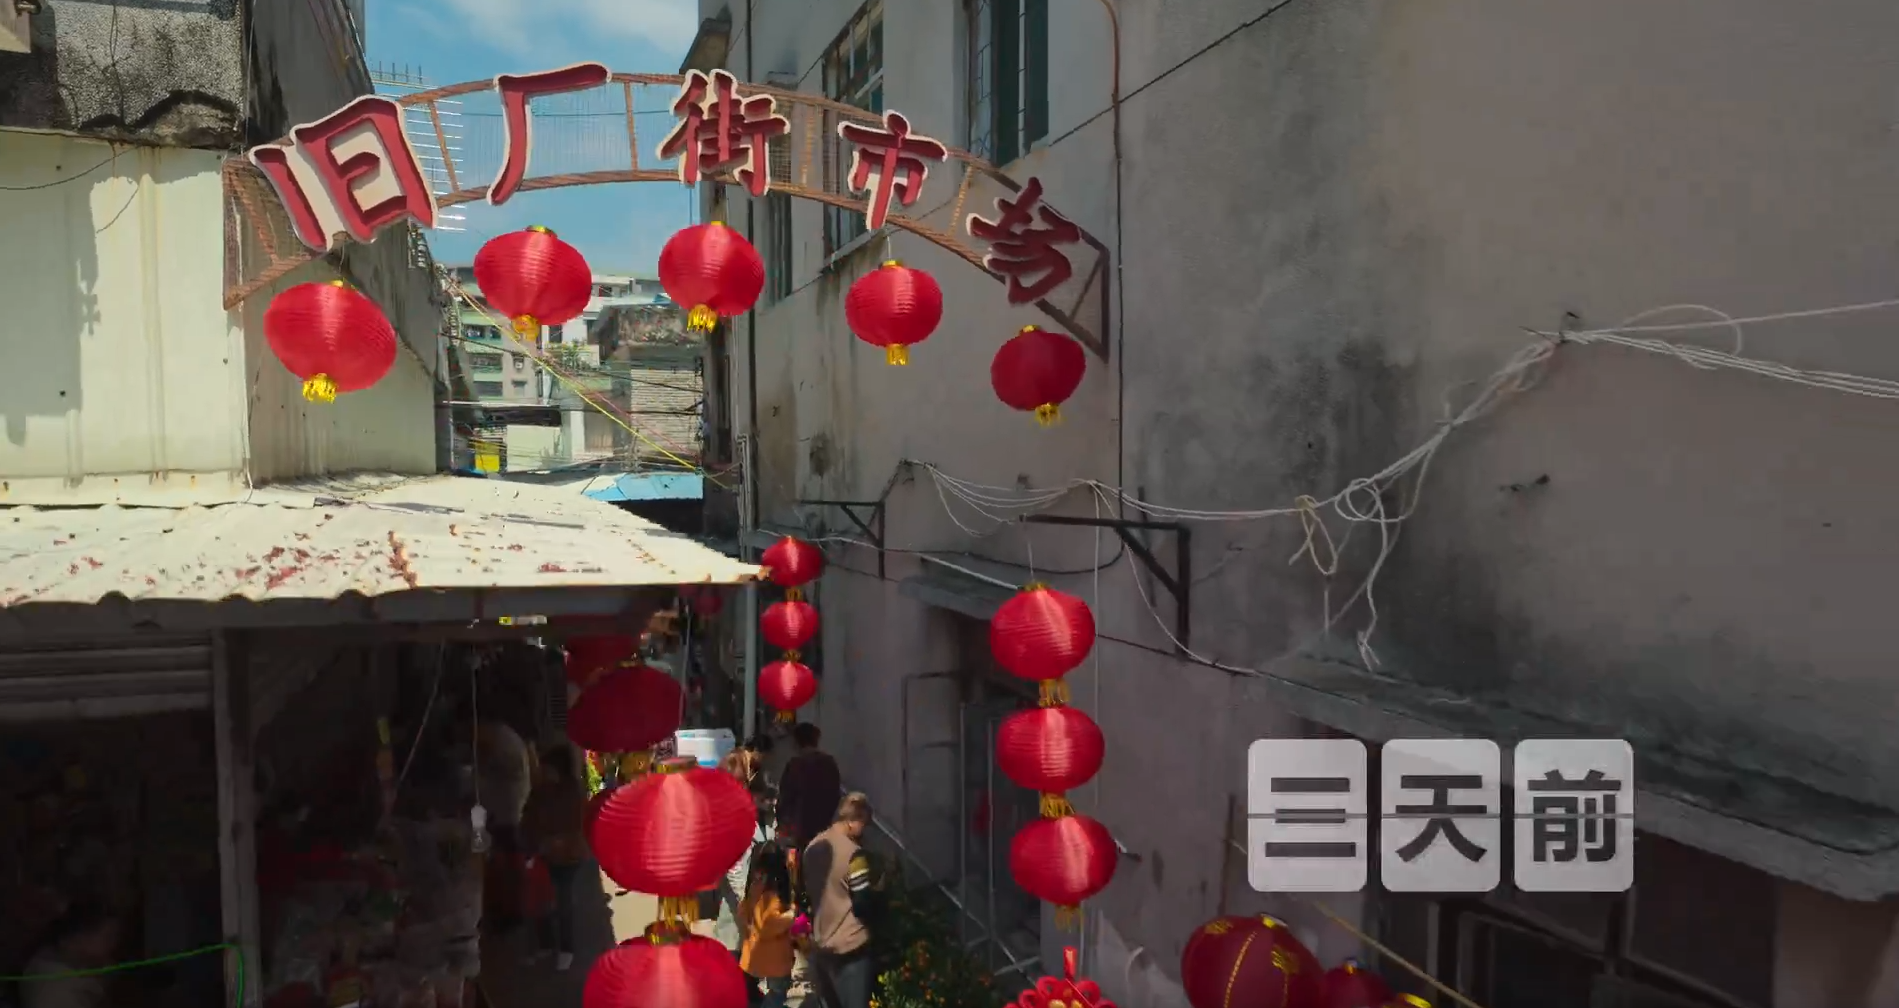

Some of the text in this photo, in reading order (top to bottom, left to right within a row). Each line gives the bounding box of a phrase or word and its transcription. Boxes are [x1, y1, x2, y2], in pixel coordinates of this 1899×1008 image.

[249, 62, 1081, 305] 旧厂街市场
